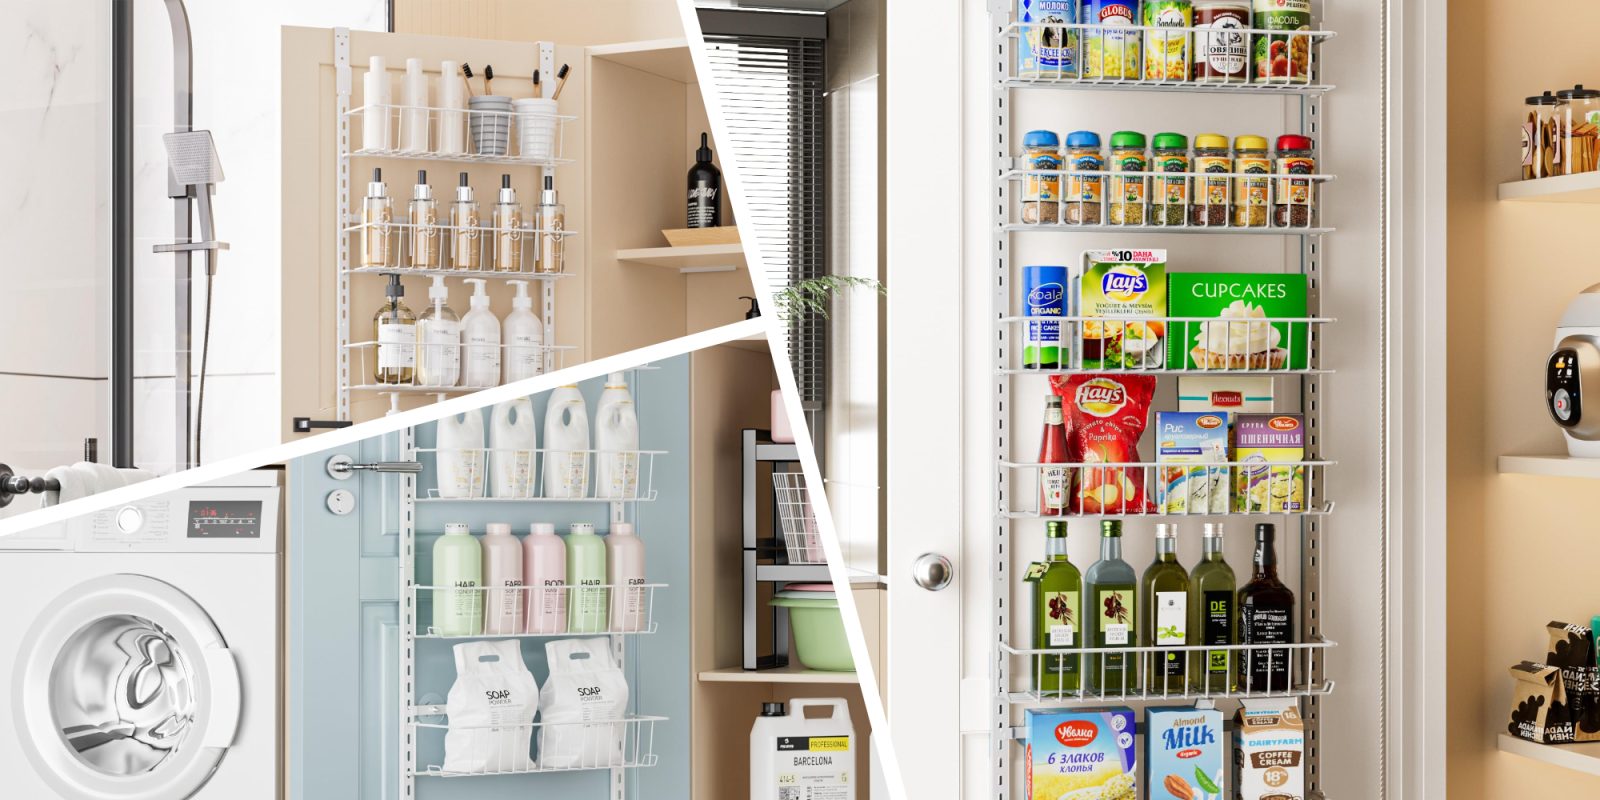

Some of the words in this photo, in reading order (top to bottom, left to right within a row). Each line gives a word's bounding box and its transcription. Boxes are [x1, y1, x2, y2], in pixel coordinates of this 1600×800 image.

[1039, 1, 1068, 11] МОЛОКО
[1101, 5, 1132, 19] GLOBUS
[1268, 15, 1299, 25] ФАСОЛЬ
[1029, 287, 1063, 301] koala
[1192, 282, 1287, 299] CUPCAKES
[1030, 307, 1062, 315] ORGANIC
[1164, 423, 1184, 433] Рис
[1088, 432, 1117, 442] Paprika
[1240, 433, 1301, 445] ПШЕНИЧНАЯ
[1210, 601, 1227, 612] DE
[486, 690, 510, 700] SOAP
[577, 686, 601, 697] SOAP
[1173, 715, 1206, 728] Almond
[1058, 726, 1094, 739] Увелка
[1162, 724, 1215, 750] Milk
[810, 740, 848, 749] PROFESSIONAL
[1248, 738, 1303, 747] DAIRYFARM
[1047, 752, 1057, 765] 6
[1060, 752, 1104, 764] злаков
[1258, 751, 1293, 760] COFFEE
[793, 756, 833, 766] BARCELONA
[1059, 764, 1093, 773] хлопья
